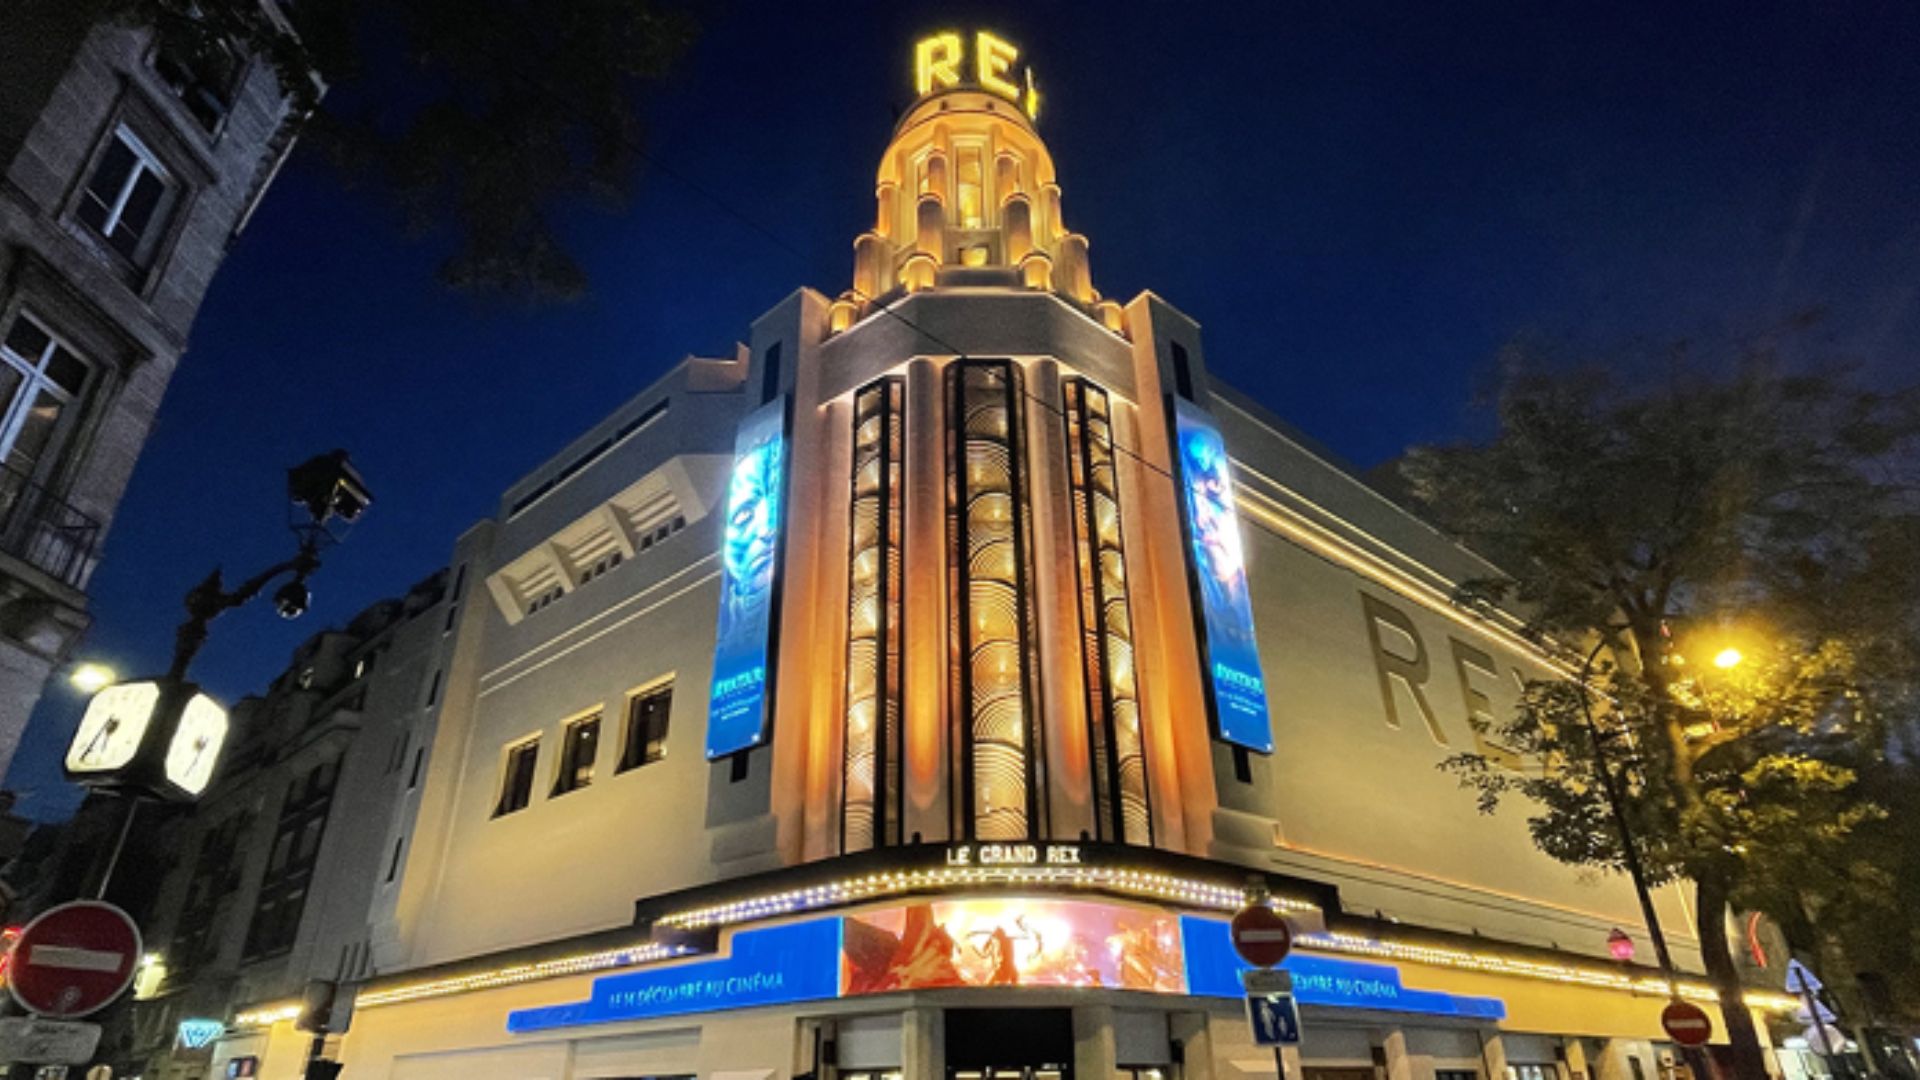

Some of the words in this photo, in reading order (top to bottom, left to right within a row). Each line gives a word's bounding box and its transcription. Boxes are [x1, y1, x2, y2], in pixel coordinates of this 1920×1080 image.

[1358, 590, 1530, 773] RE
[947, 846, 970, 865] LE
[979, 845, 1037, 863] GRAND
[1046, 845, 1081, 863] REX
[726, 971, 783, 996] CINÉMA
